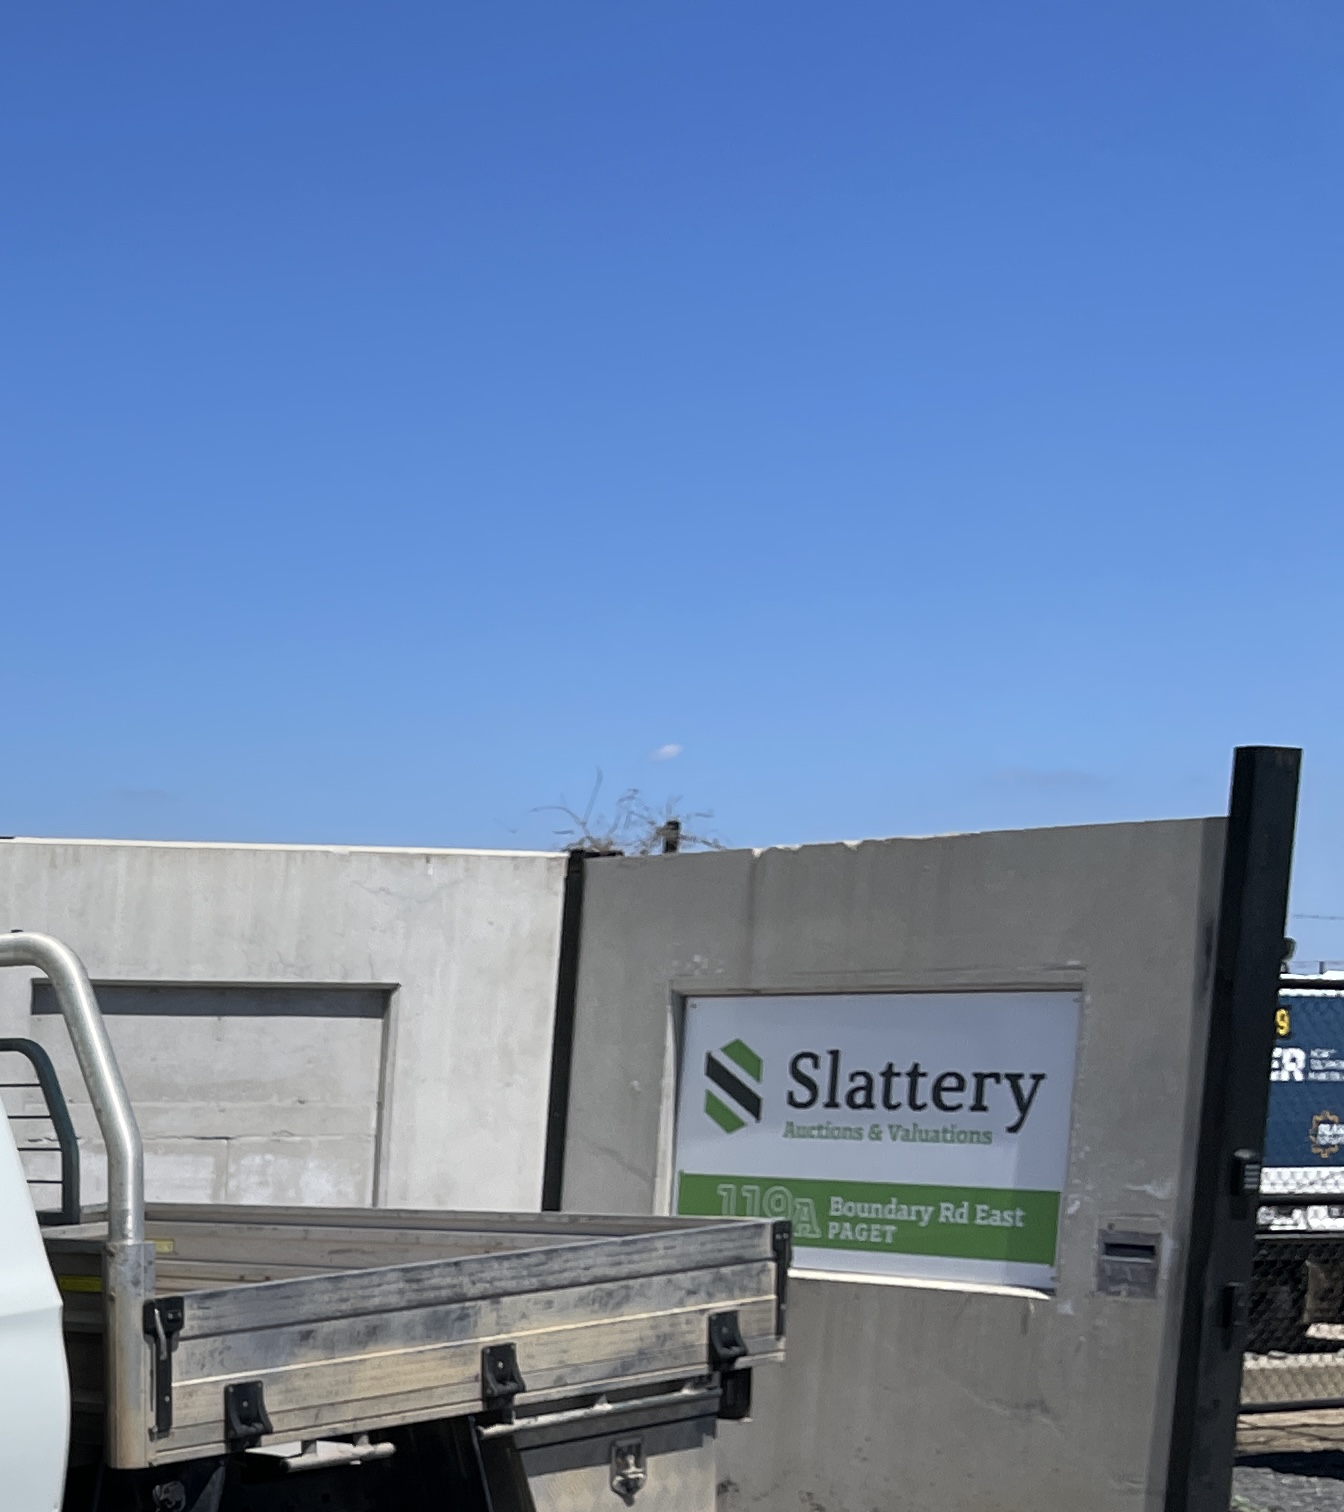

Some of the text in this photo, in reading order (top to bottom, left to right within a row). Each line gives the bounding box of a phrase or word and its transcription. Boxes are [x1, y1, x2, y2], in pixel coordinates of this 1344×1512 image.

[786, 1050, 1047, 1134] Slattery
[783, 1121, 992, 1145] Auctions & Valuations
[829, 1196, 935, 1227] Boundary
[938, 1201, 969, 1224] Rd
[975, 1204, 1026, 1227] East
[828, 1222, 897, 1243] PAGET
